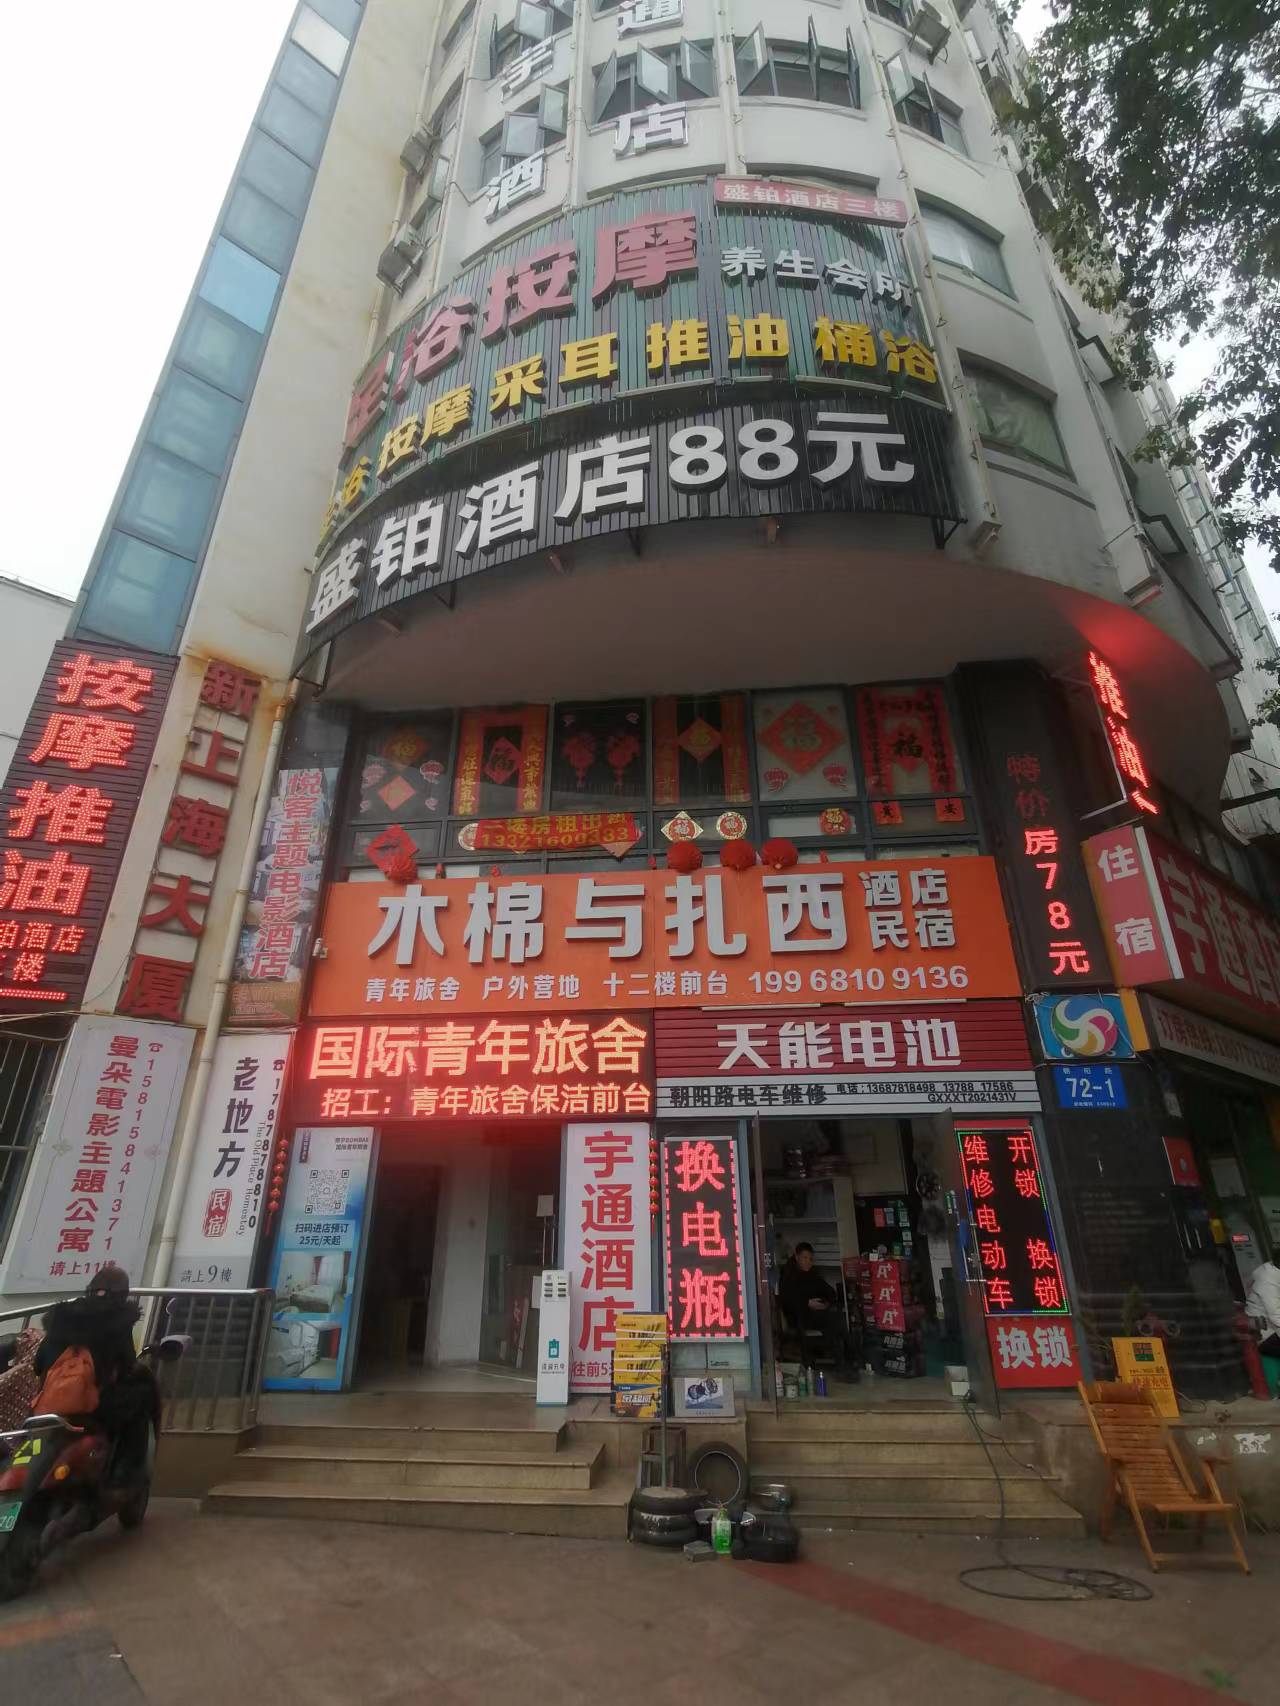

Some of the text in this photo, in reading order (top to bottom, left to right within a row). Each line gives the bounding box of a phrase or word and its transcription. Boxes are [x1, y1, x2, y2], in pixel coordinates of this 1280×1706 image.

[723, 183, 900, 219] 盛铂酒店三楼
[720, 246, 909, 305] 养生会所
[0, 652, 154, 918] 按摩推油
[117, 660, 262, 1022] 新上海大厦
[248, 769, 324, 980] 悦客主题电影酒店
[367, 873, 848, 966] 木棉与扎西
[858, 868, 949, 908] 酒店
[1098, 844, 1156, 956] 住宿
[868, 908, 956, 951] 民宿
[366, 966, 969, 1002] 青年旅舍 户外营地 十二楼前台 199 6810 9136
[309, 1016, 648, 1080] 国际青年旅舍
[716, 1018, 961, 1070] 天能电池
[213, 1056, 259, 1179] 老地方
[669, 1083, 829, 1108] 朝阳路电车维修
[1065, 1077, 1115, 1099] 72-1
[57, 1035, 140, 1254] 曼朵電影主題公寓
[104, 1058, 154, 1250] 15815841371
[295, 1222, 349, 1235] 扫码进店预订
[578, 1130, 635, 1352] 宇通酒店
[674, 1140, 734, 1329] 换电瓶
[963, 1135, 1014, 1311] 维修电动车
[1008, 1136, 1062, 1309] 开锁 换锁
[572, 1360, 613, 1377] 往前5
[996, 1325, 1073, 1370] 换锁
